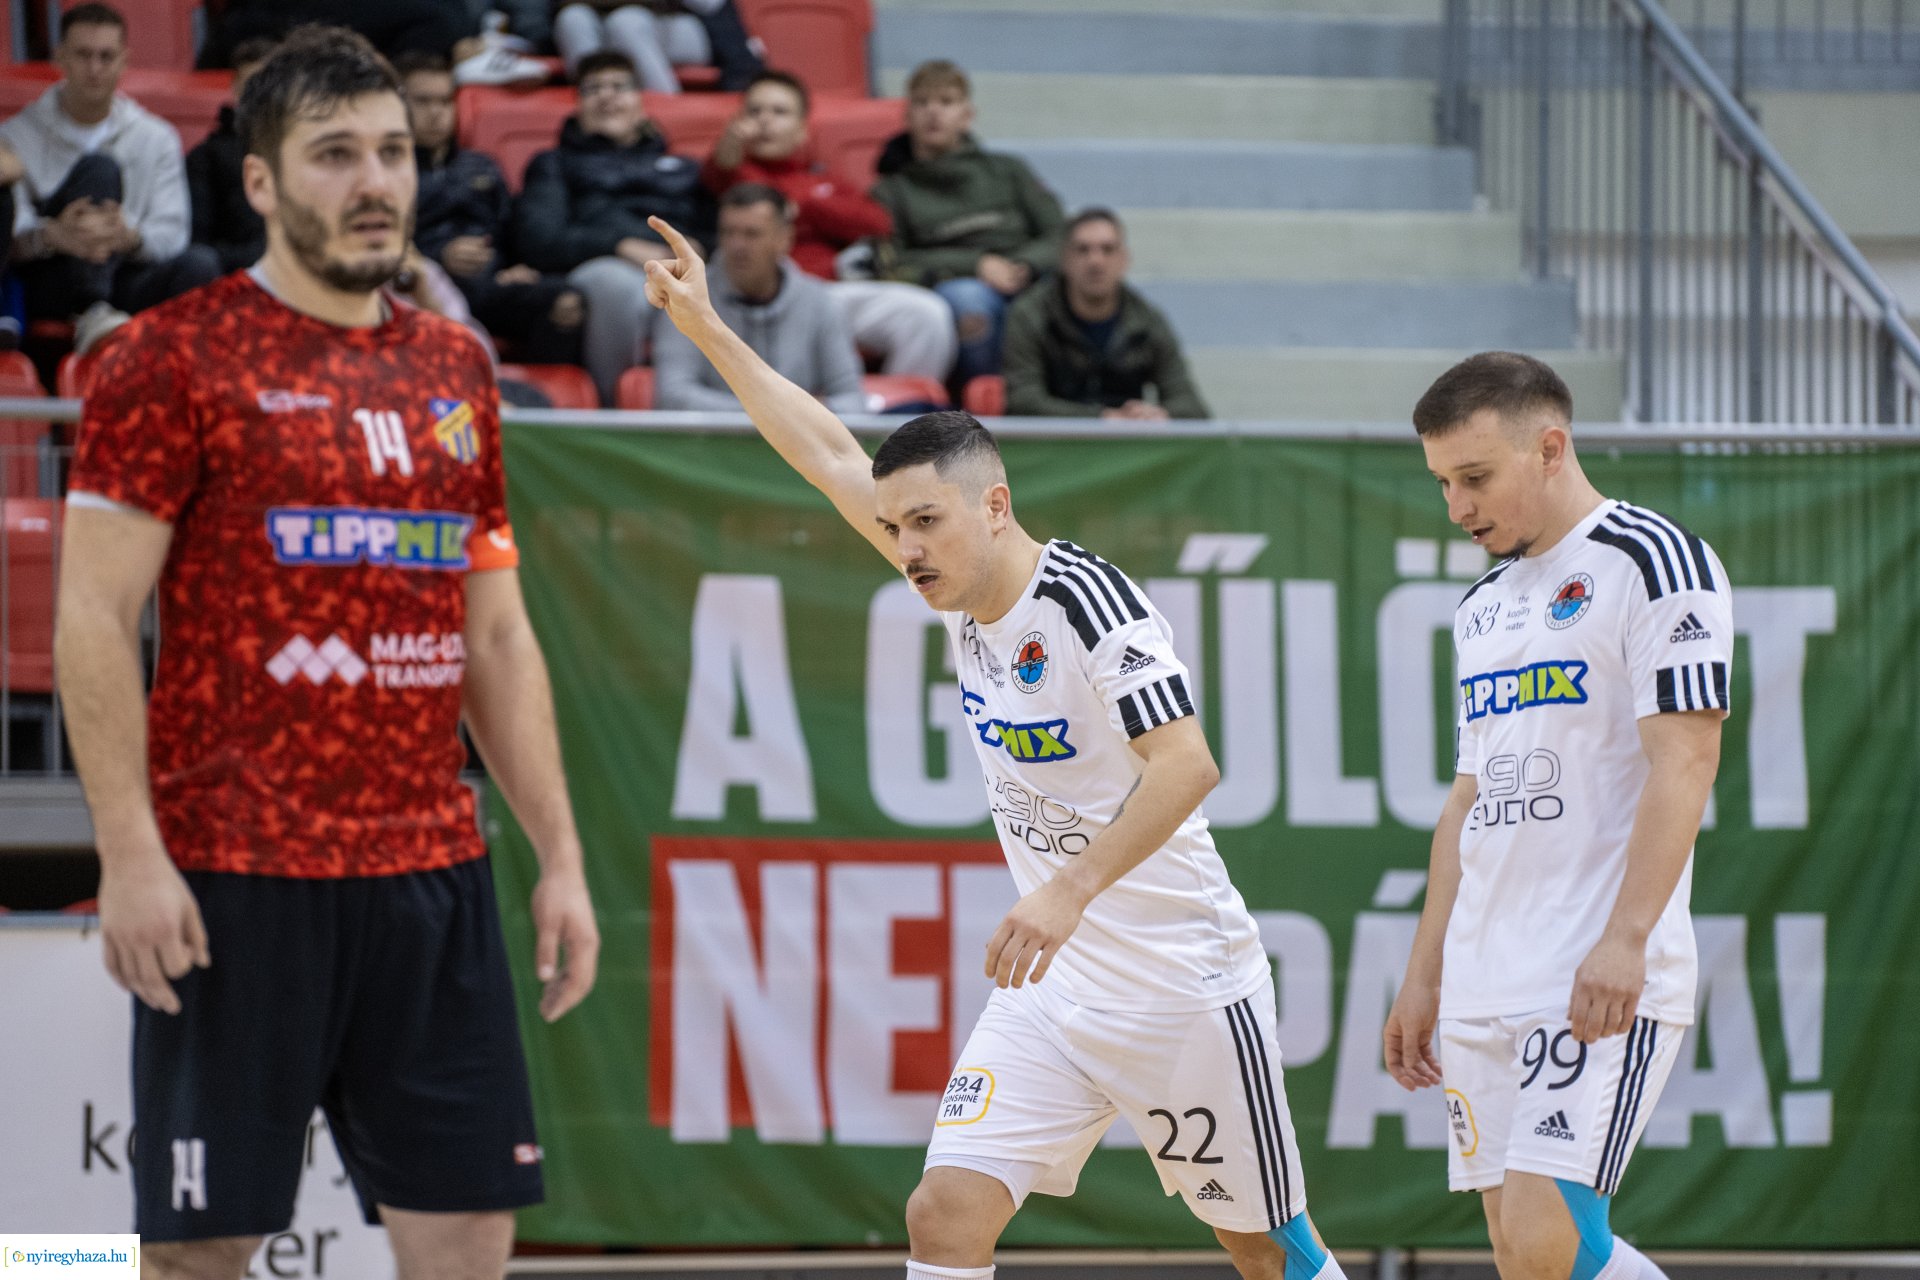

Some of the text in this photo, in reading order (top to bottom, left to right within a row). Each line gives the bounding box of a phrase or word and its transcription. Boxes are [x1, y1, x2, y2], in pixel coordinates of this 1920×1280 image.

[352, 408, 414, 477] 14
[1669, 629, 1712, 643] adidas
[1119, 654, 1156, 676] adidas
[671, 573, 818, 823] A
[667, 859, 1016, 1147] NE
[1520, 1027, 1588, 1091] 99
[946, 1075, 984, 1095] 99.4
[943, 1094, 979, 1105] SUNSHINE
[943, 1103, 964, 1118] FM
[1147, 1106, 1224, 1165] 22
[1534, 1125, 1576, 1142] adidas
[1196, 1190, 1235, 1202] adidas
